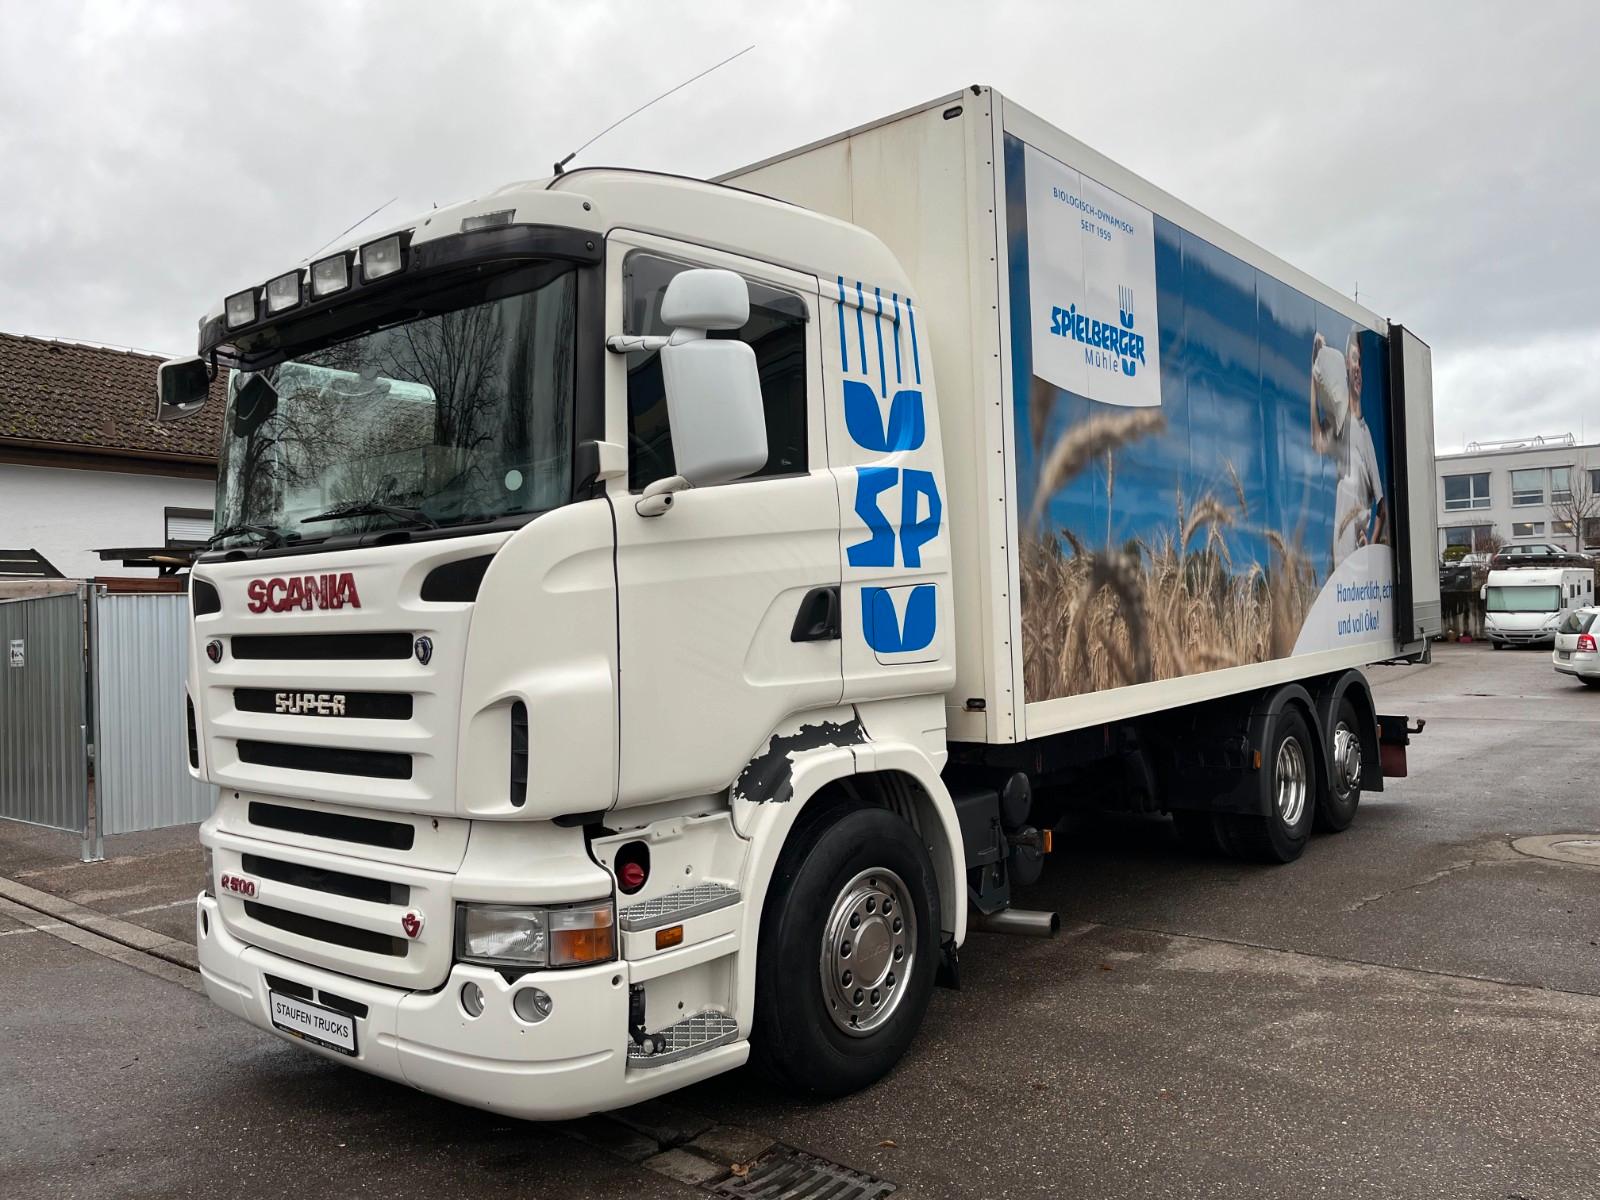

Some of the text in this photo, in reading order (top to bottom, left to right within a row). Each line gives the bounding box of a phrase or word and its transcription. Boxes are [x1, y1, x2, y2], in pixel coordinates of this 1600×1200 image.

[1080, 219, 1112, 241] SEIT 1959
[1085, 347, 1119, 373] Mühle
[247, 572, 361, 614] SCANIA
[1383, 580, 1393, 600] ech
[1338, 613, 1351, 635] und
[1365, 609, 1379, 631] Öko!
[275, 692, 346, 715] SUPER
[230, 877, 255, 897] 500
[276, 1003, 349, 1038] STAUFEN TRUCKS
